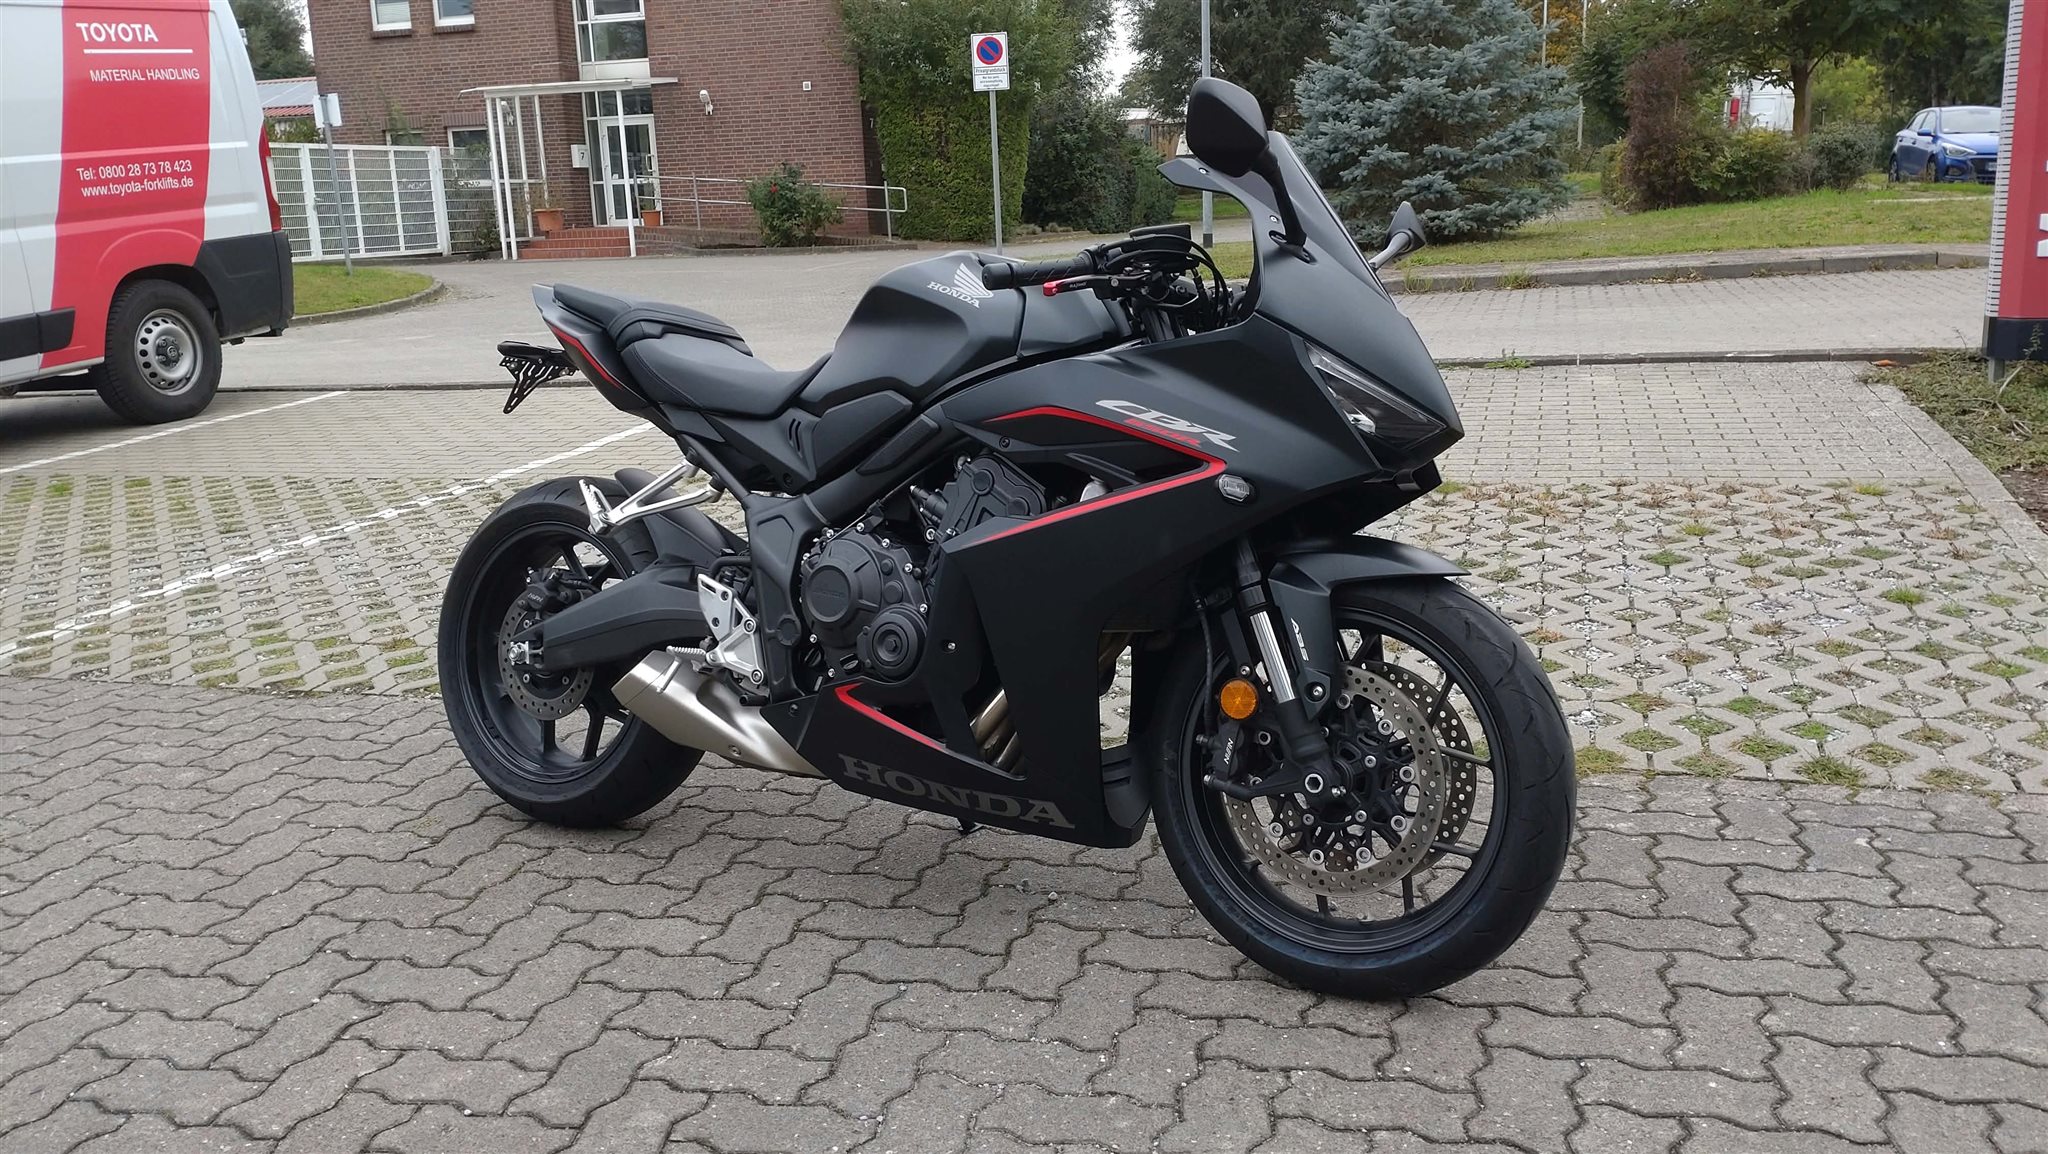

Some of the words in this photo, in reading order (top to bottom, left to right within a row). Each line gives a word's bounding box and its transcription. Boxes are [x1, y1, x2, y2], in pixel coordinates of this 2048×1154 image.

[75, 22, 159, 42] TOYOTA
[89, 68, 146, 82] MATERIAL
[146, 67, 200, 81] HANDLING
[580, 152, 585, 160] 7
[76, 167, 97, 181] Tel:
[98, 164, 125, 179] 0800
[127, 163, 141, 177] 28
[143, 162, 157, 175] 73
[158, 161, 172, 174] 78
[173, 159, 192, 172] 423
[81, 176, 194, 197] www.toyota-forklifts.de
[927, 281, 979, 308] HONDA
[1095, 399, 1240, 453] CBR
[837, 753, 1076, 829] HONDA
